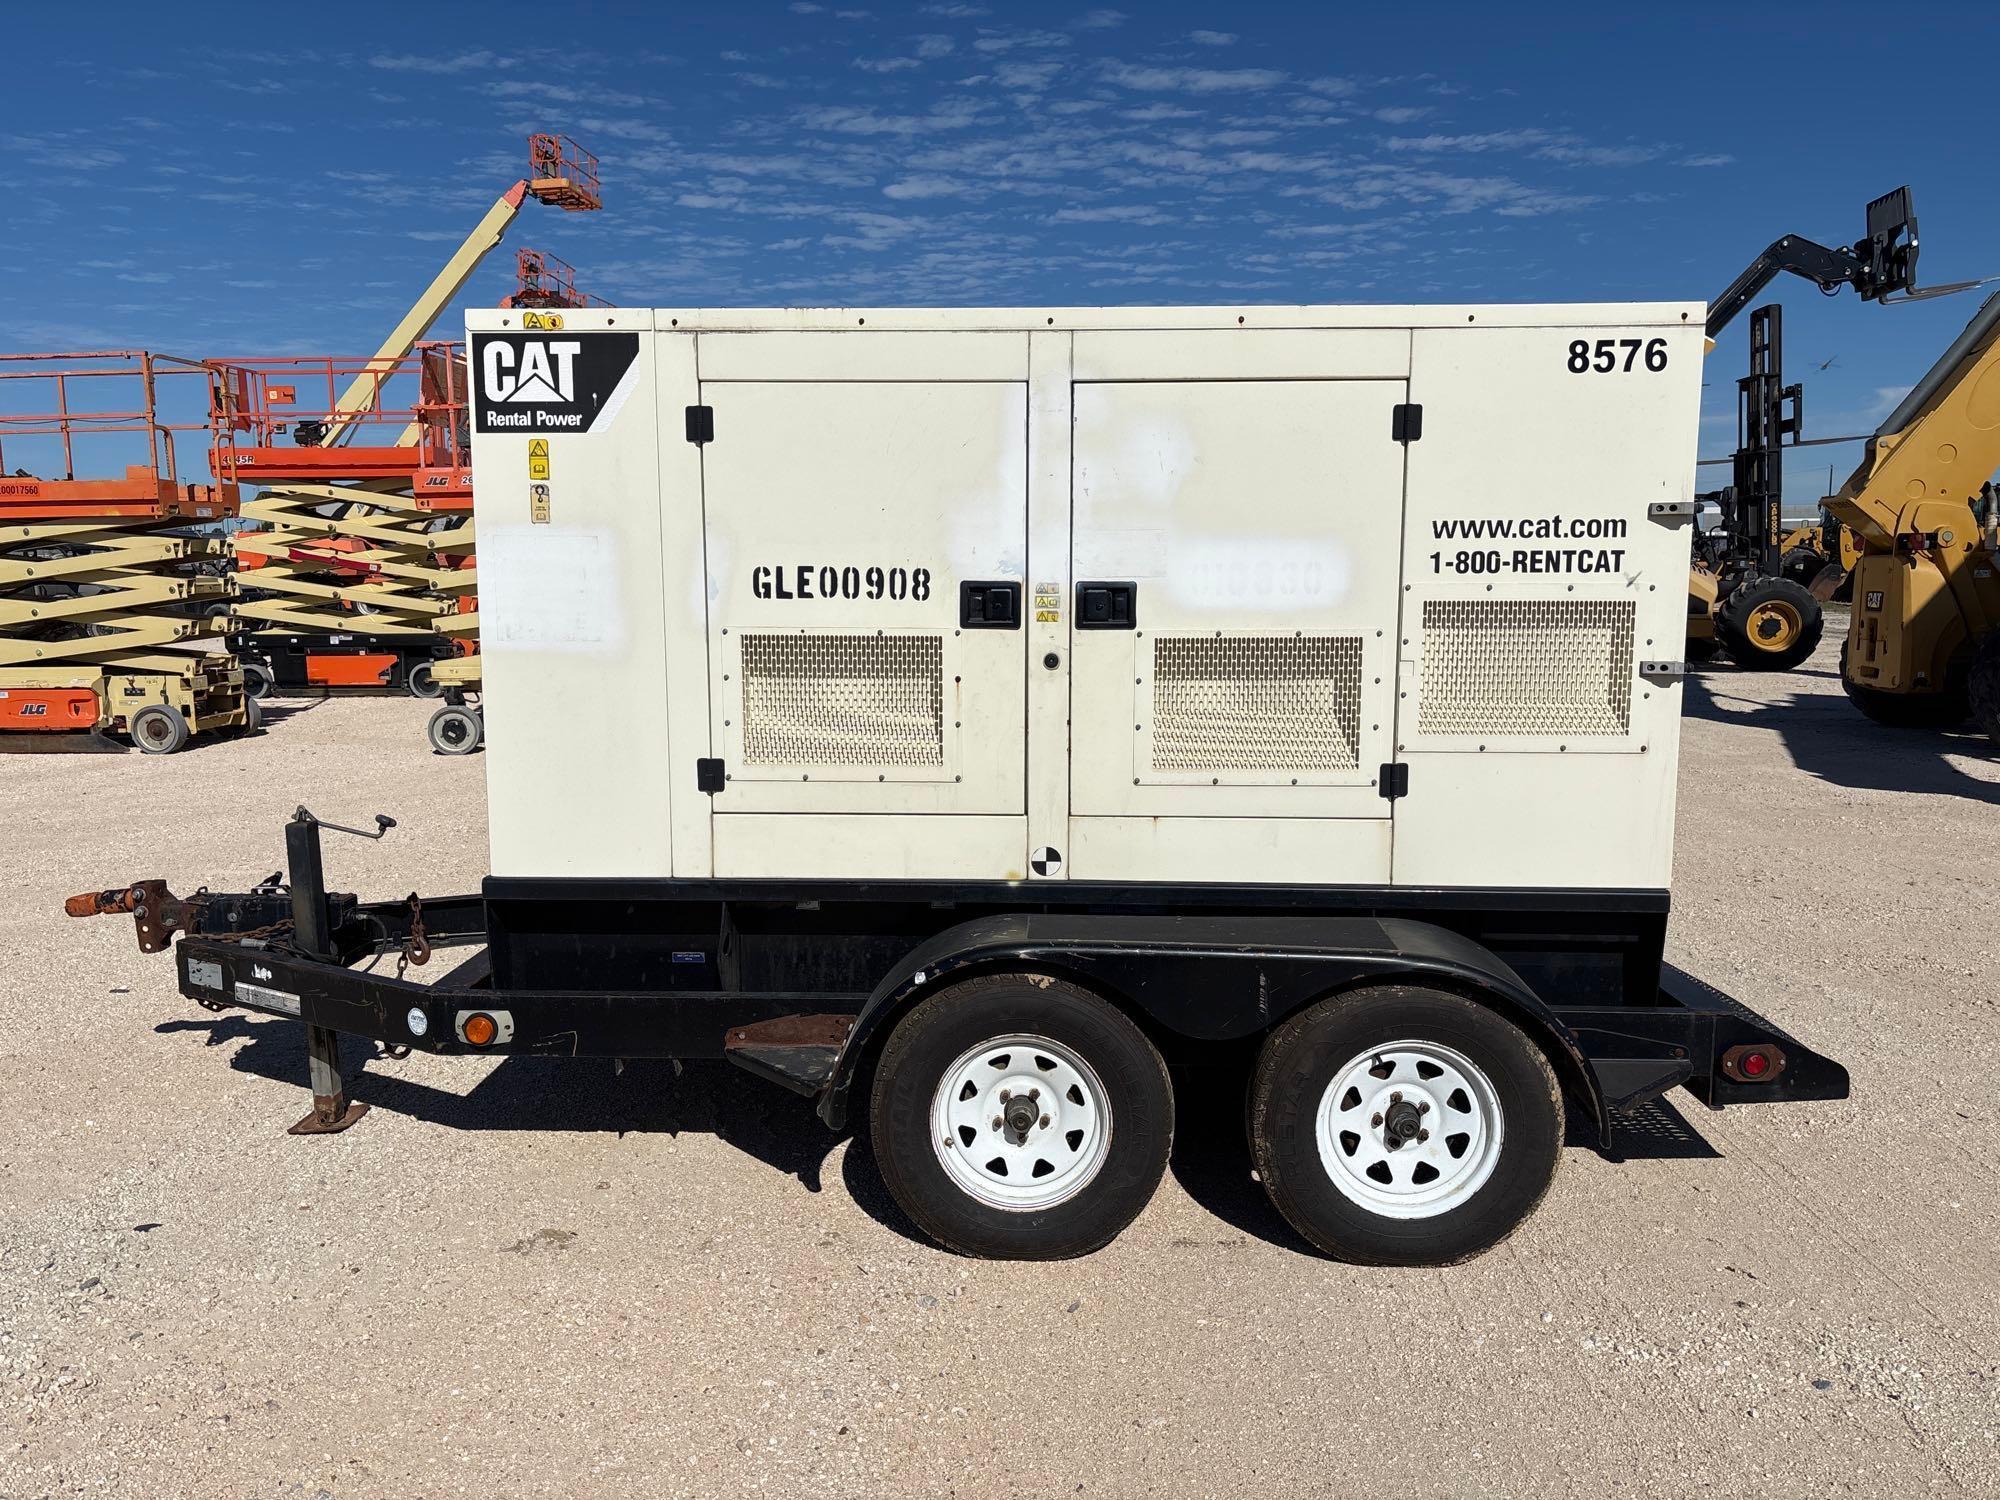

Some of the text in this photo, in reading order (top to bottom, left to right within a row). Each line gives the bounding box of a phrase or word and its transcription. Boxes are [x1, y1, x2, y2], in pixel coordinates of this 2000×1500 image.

[1567, 338, 1668, 374] 8576
[484, 340, 581, 403] CAT
[487, 410, 583, 427] Rental Power
[0, 485, 39, 495] 00017560
[426, 477, 449, 486] JLG
[1432, 514, 1627, 539] www.cat.com
[1430, 549, 1626, 574] 1-800-RENTCAT
[754, 565, 932, 602] GLE00908
[20, 704, 46, 715] JLG
